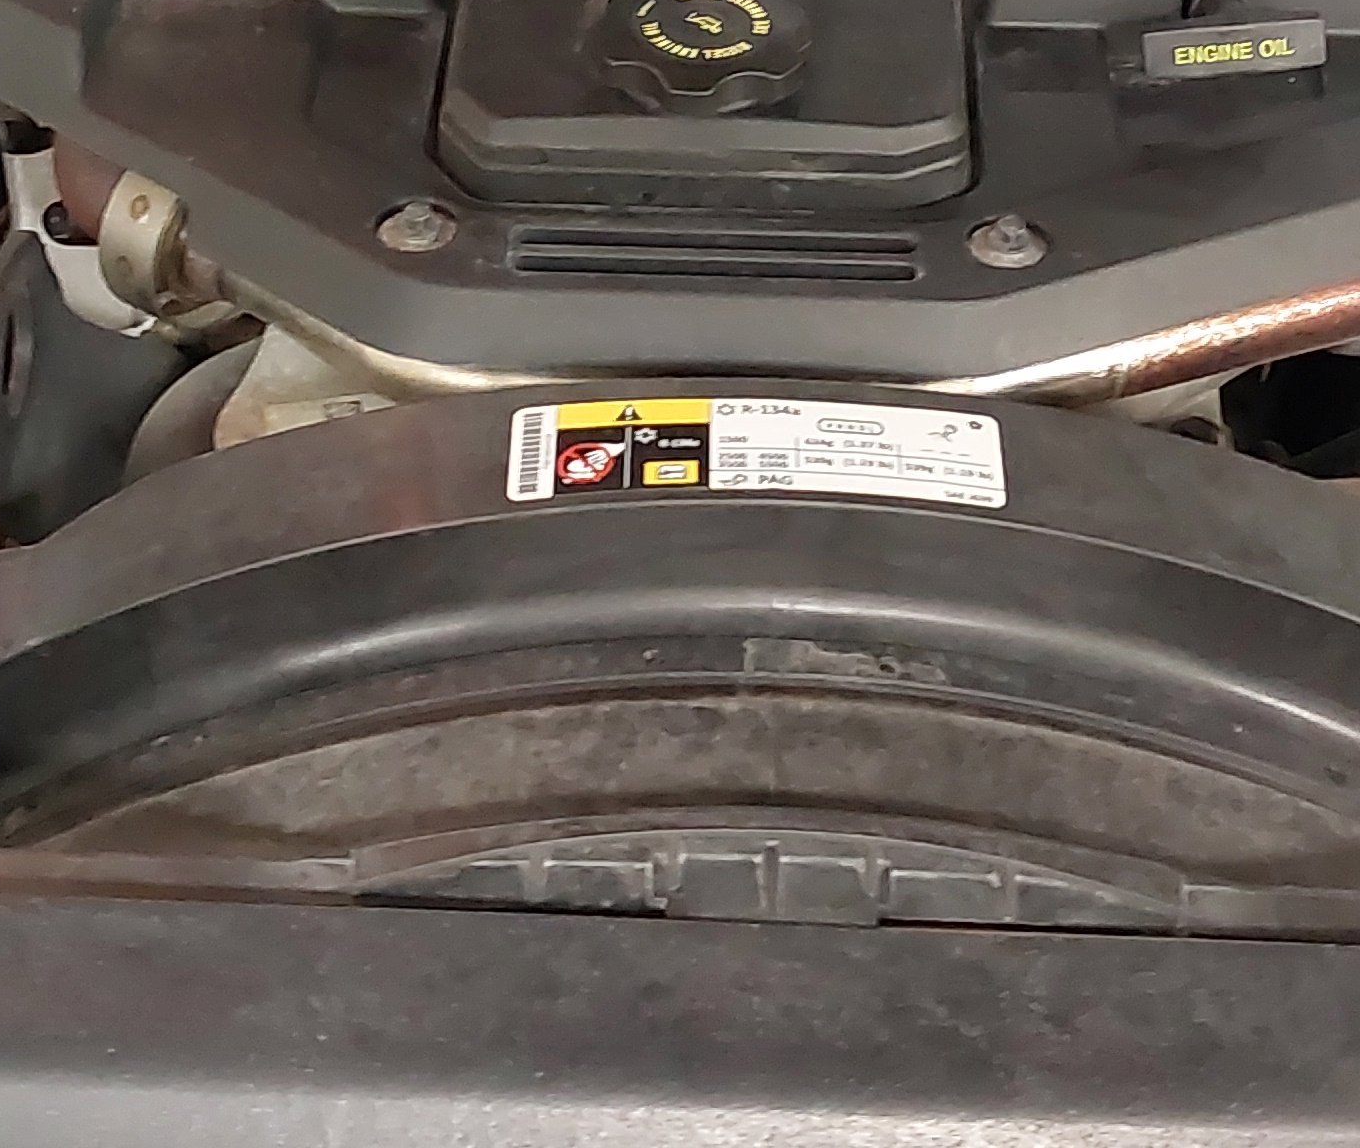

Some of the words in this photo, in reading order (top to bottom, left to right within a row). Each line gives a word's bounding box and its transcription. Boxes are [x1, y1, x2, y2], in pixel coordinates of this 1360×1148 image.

[1174, 41, 1254, 65] ENGINE
[1258, 37, 1296, 58] OIL
[757, 474, 793, 486] PAG
